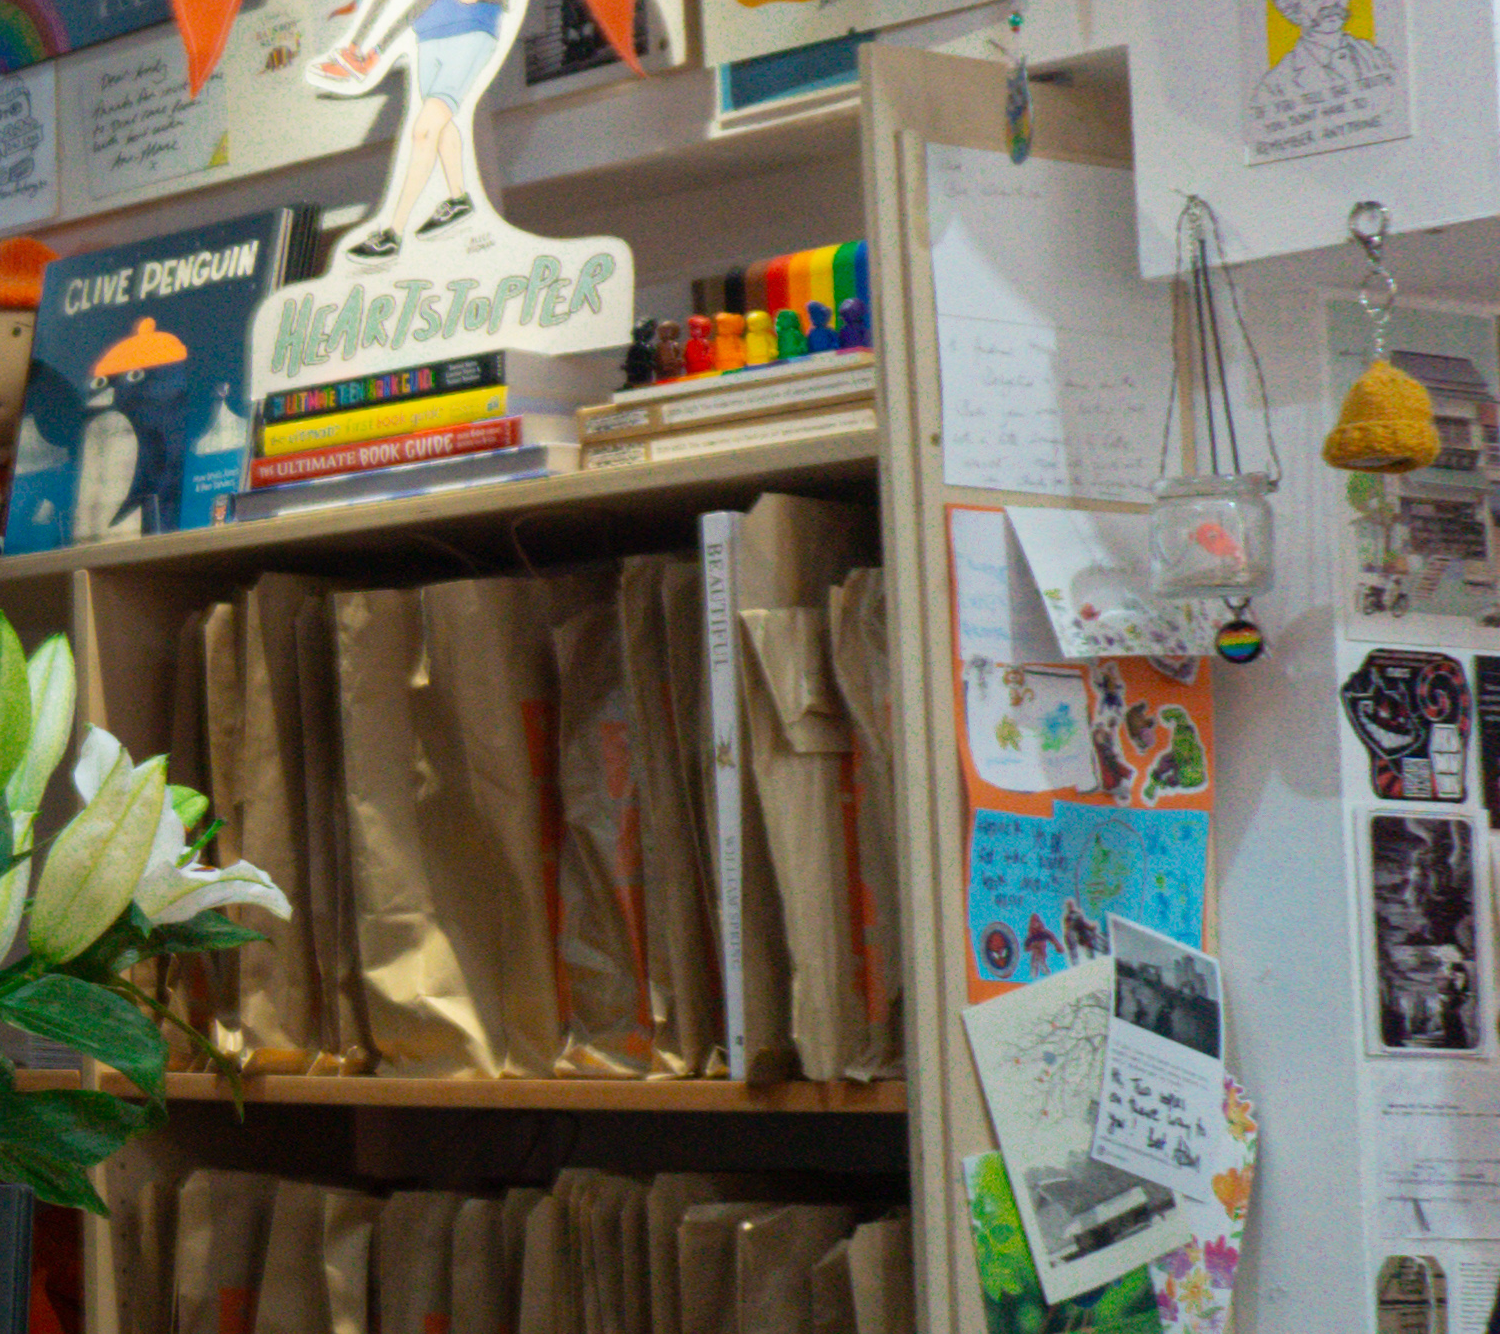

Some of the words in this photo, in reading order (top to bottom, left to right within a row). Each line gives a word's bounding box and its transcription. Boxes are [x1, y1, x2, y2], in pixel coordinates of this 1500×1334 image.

[64, 263, 131, 317] CLIVE
[138, 239, 260, 302] PENGUIN
[272, 253, 616, 377] HEARTSTOPPER
[277, 452, 356, 476] ULTIMATE
[360, 443, 400, 466] BOOK
[405, 433, 454, 455] GUIDE
